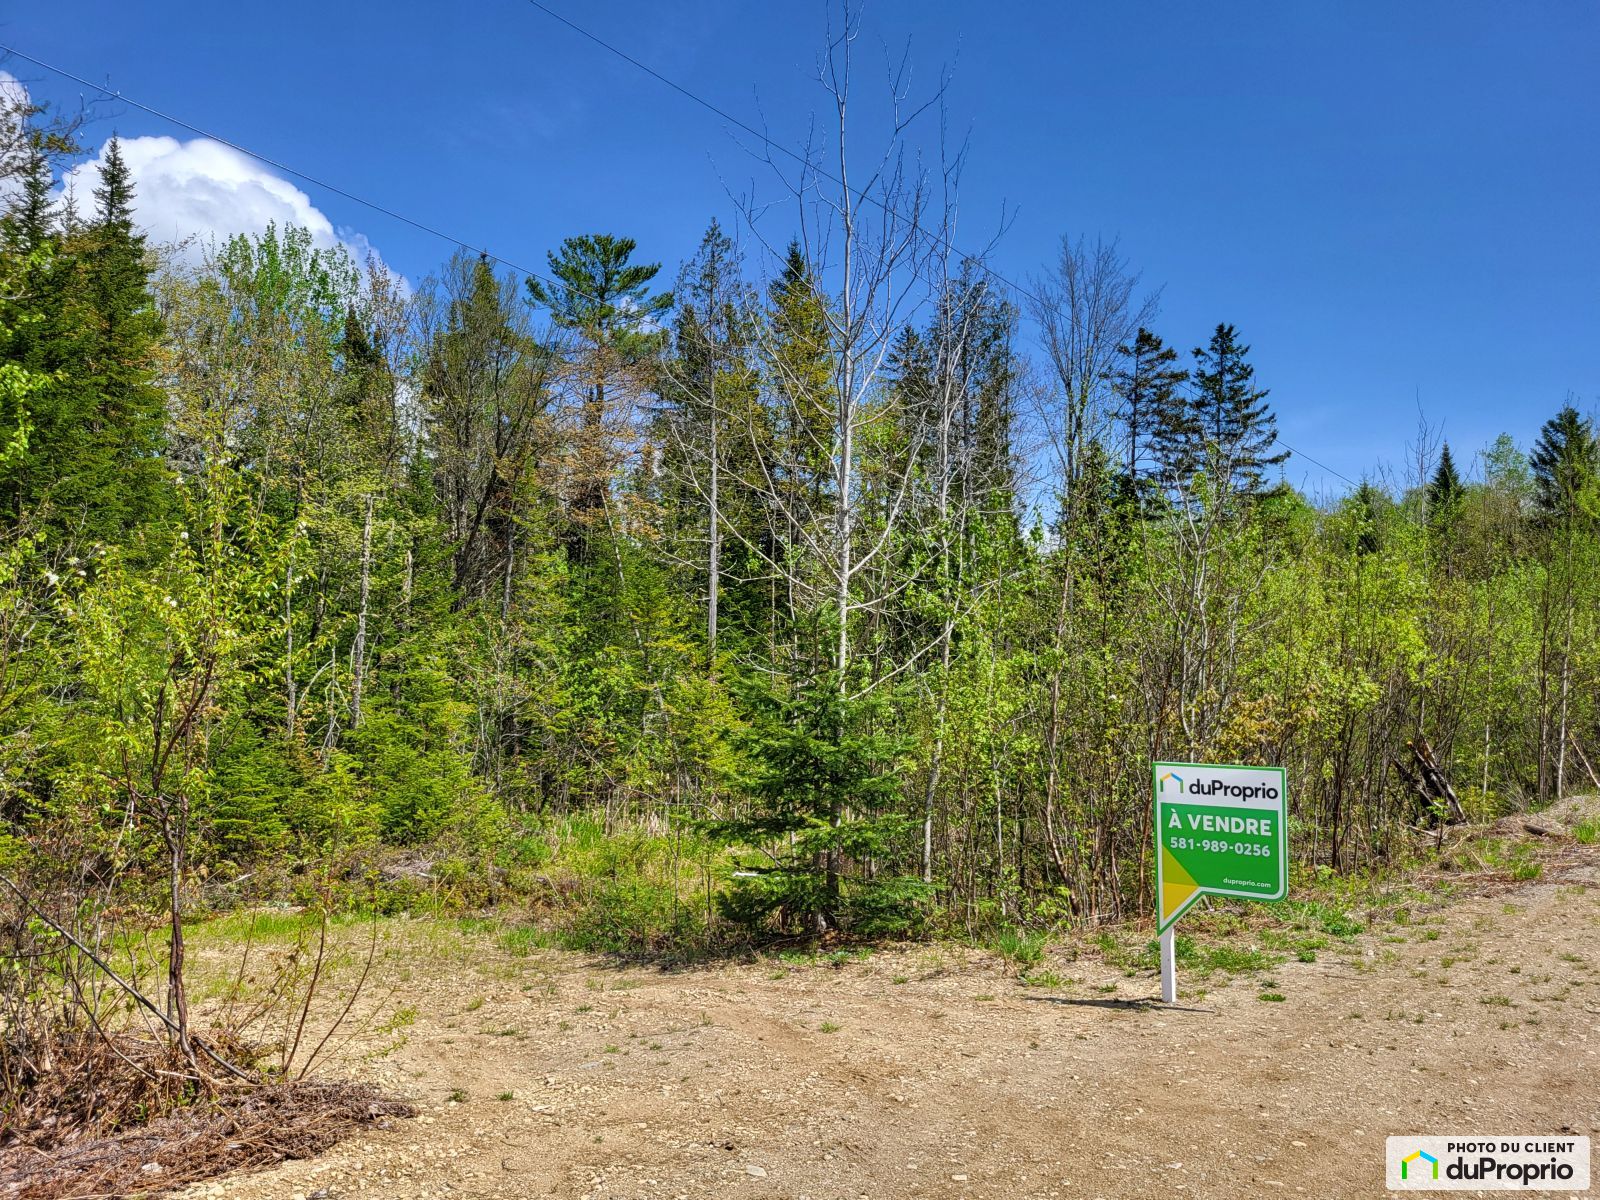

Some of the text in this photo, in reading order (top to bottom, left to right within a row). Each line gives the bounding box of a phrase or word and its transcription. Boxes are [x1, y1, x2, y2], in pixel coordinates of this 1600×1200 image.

[1189, 778, 1279, 801] duProprio
[1168, 808, 1272, 837] À VENDRE
[1170, 837, 1271, 857] 581-989-0256
[1223, 877, 1271, 888] duproprio.com
